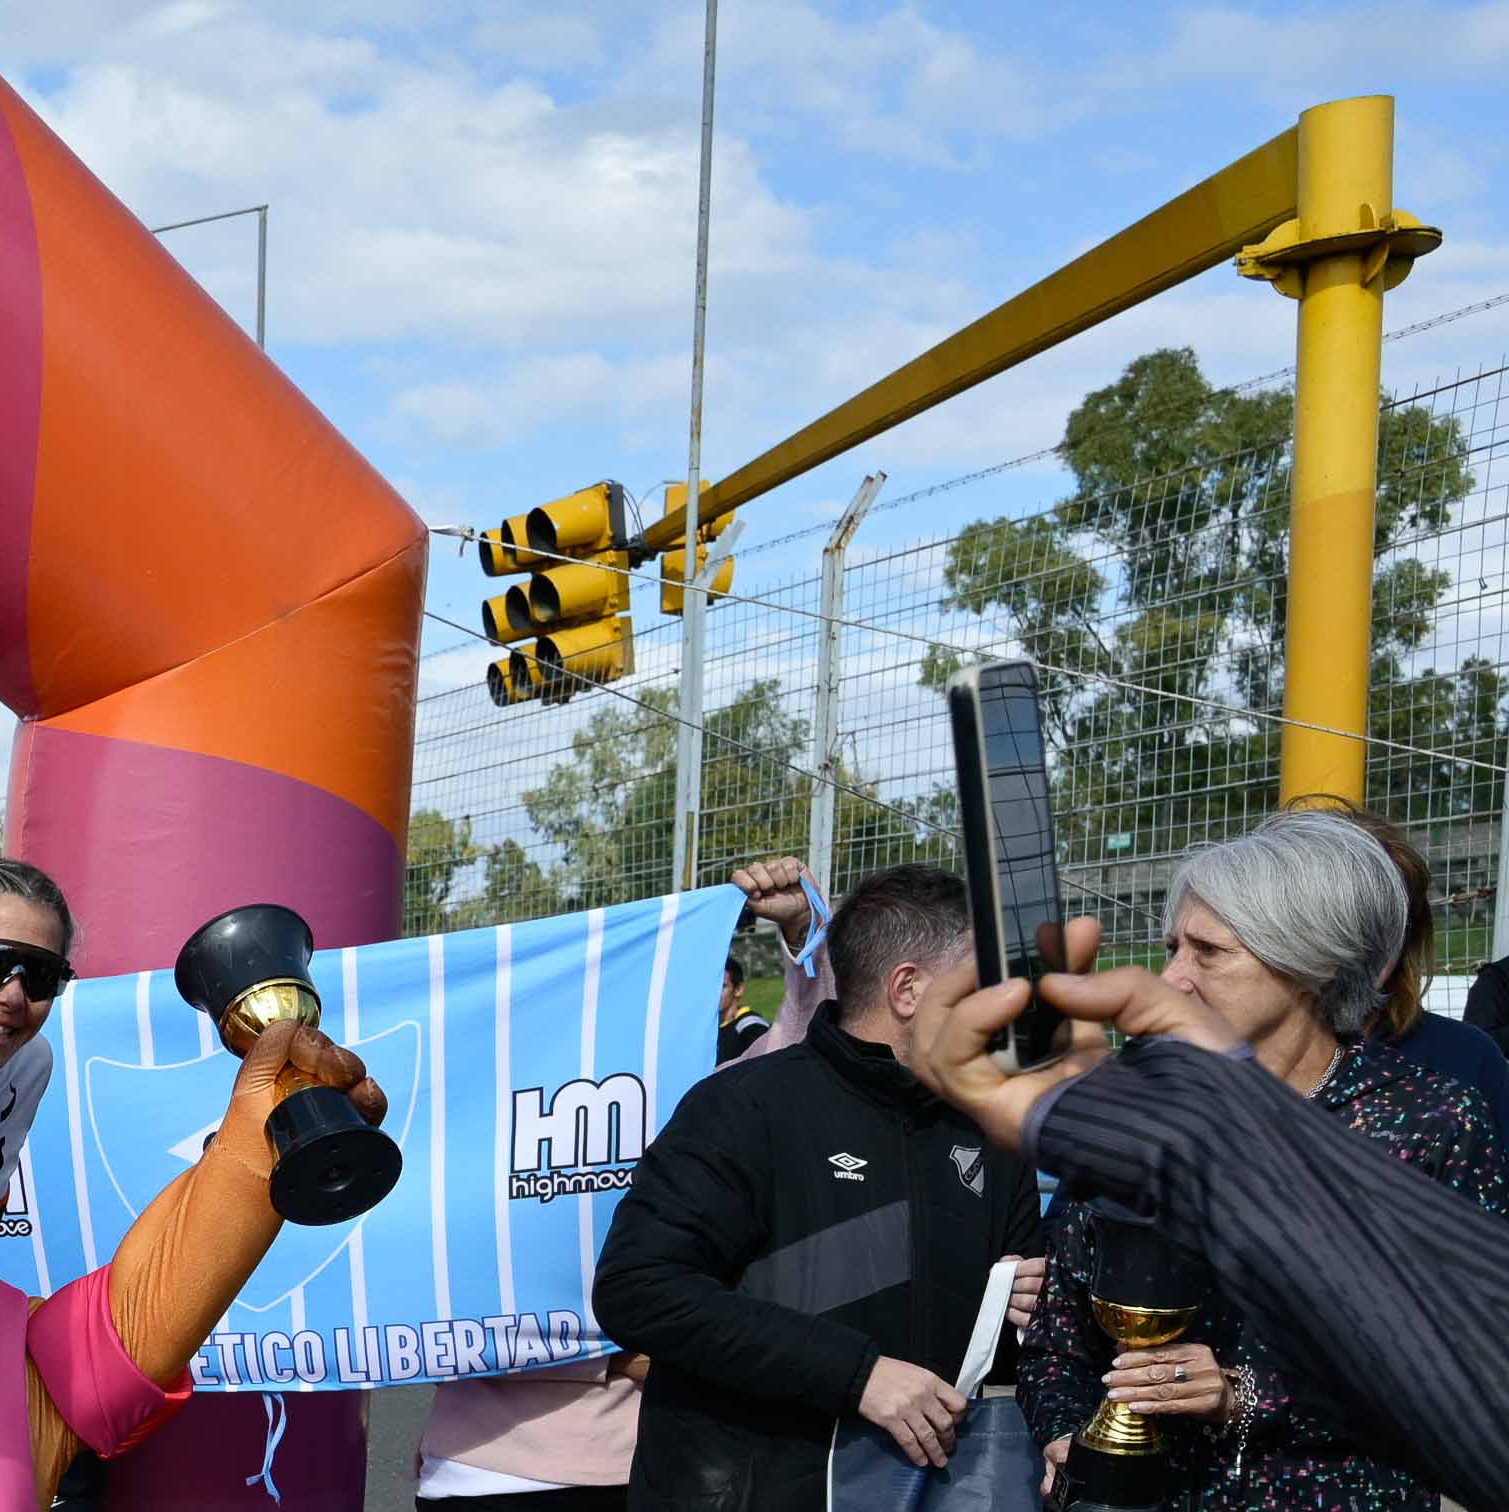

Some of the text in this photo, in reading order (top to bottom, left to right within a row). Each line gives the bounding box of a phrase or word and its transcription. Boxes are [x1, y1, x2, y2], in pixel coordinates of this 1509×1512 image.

[833, 1170, 865, 1182] umbro
[189, 1310, 582, 1386] ETICO LIBERTAD
